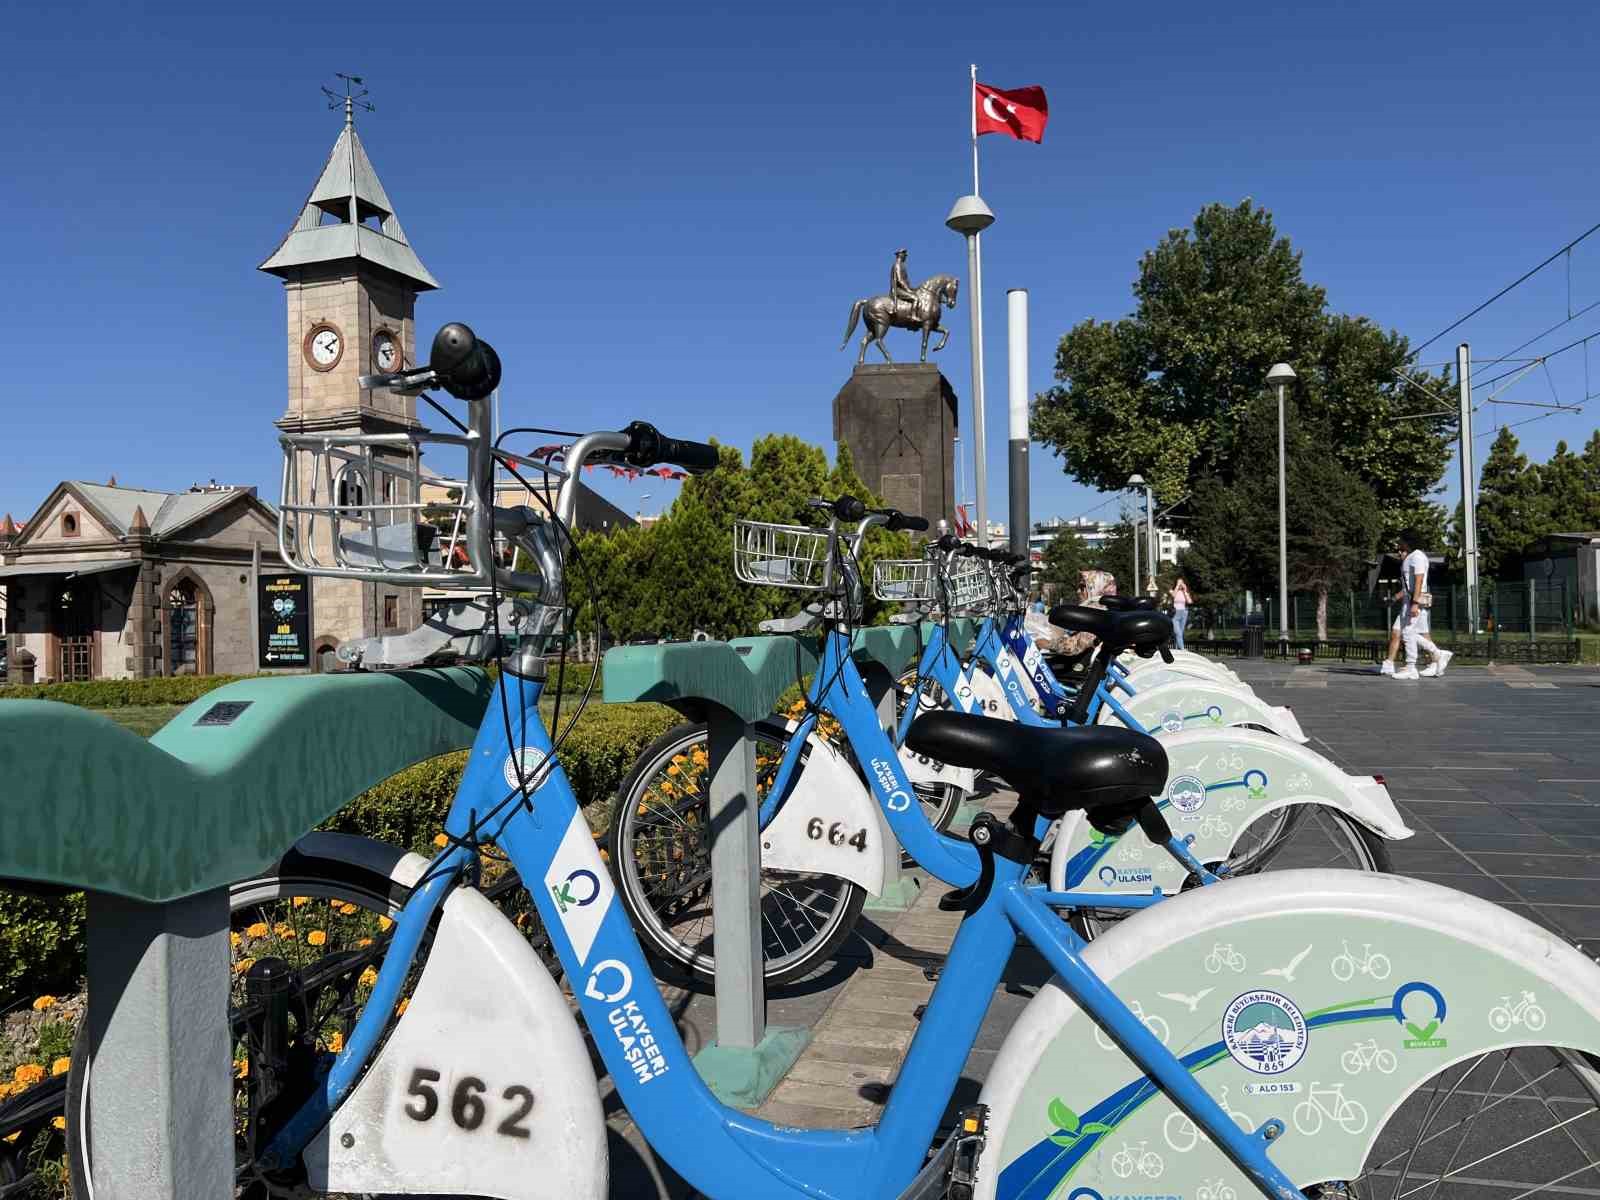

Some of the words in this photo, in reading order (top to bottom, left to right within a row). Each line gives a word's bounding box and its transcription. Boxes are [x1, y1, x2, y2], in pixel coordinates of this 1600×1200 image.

[807, 817, 867, 852] 664
[608, 1007, 654, 1084] ULAŞIM
[623, 1000, 669, 1076] KAYSERİ
[1258, 1060, 1284, 1071] 1869
[1280, 1084, 1294, 1092] 153
[405, 1067, 535, 1138] 562
